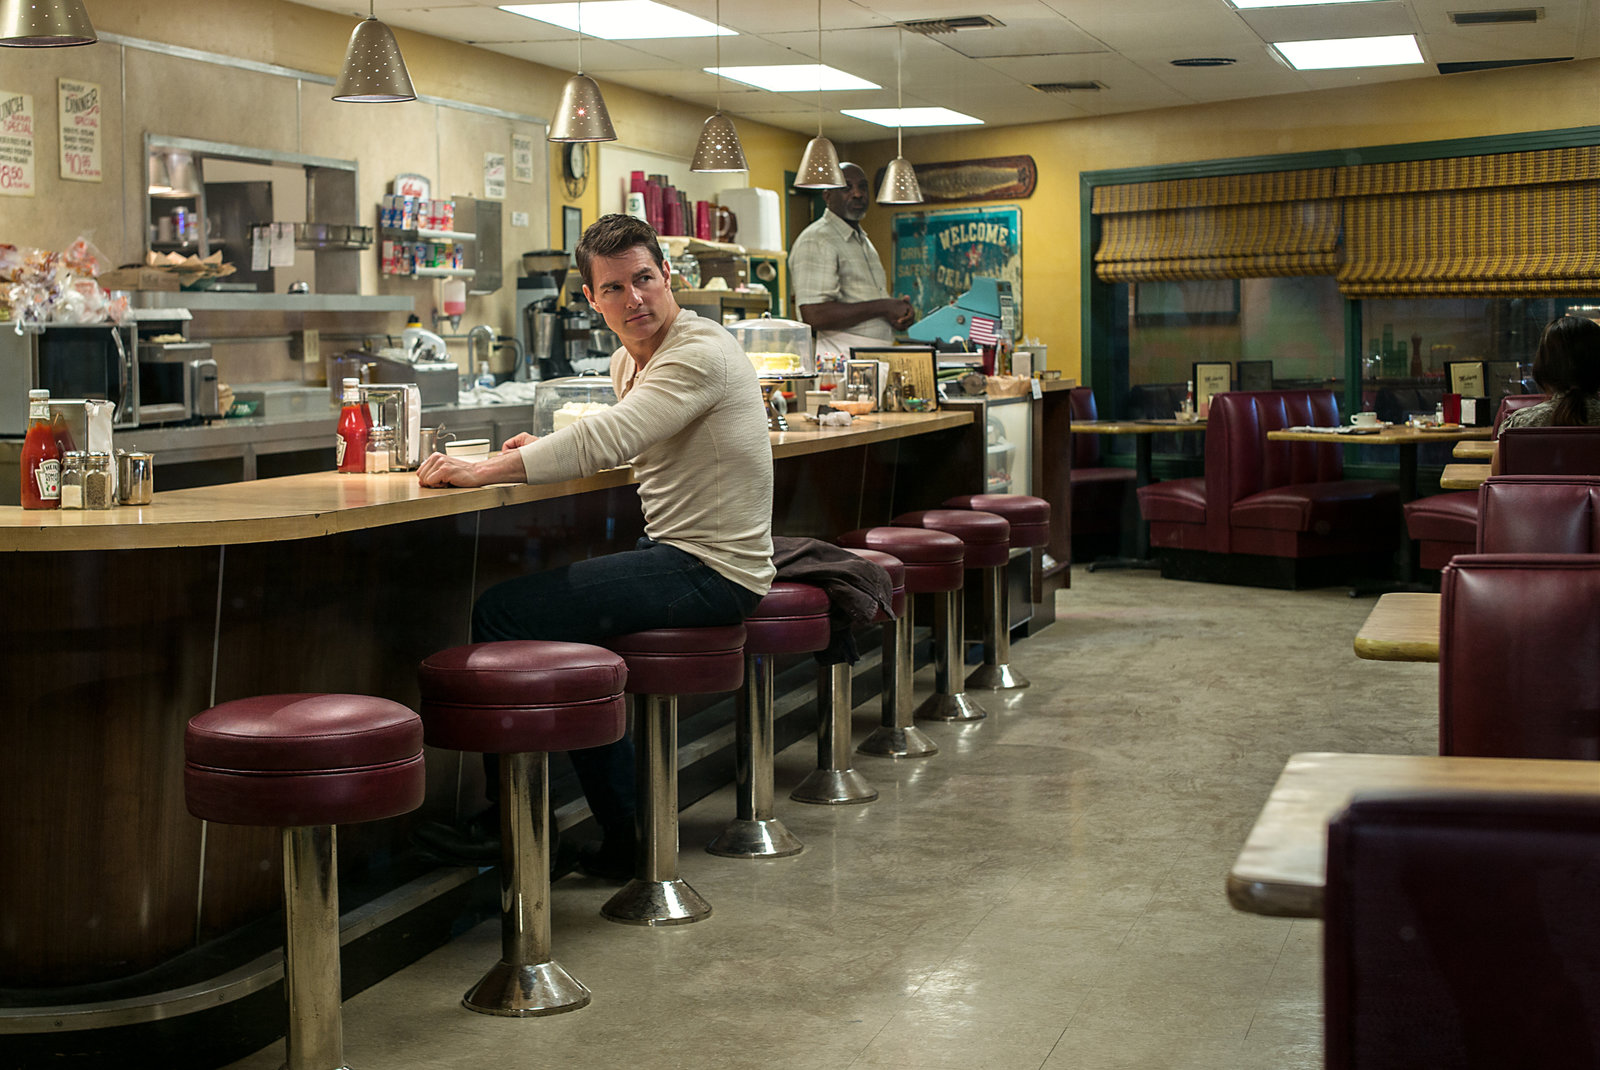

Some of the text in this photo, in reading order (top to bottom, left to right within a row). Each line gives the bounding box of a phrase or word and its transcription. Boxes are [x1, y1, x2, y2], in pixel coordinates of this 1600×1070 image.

[65, 87, 98, 113] DINNER
[939, 222, 1009, 250] WELCOME
[901, 246, 928, 260] DRIVE
[898, 264, 931, 278] SAFELY
